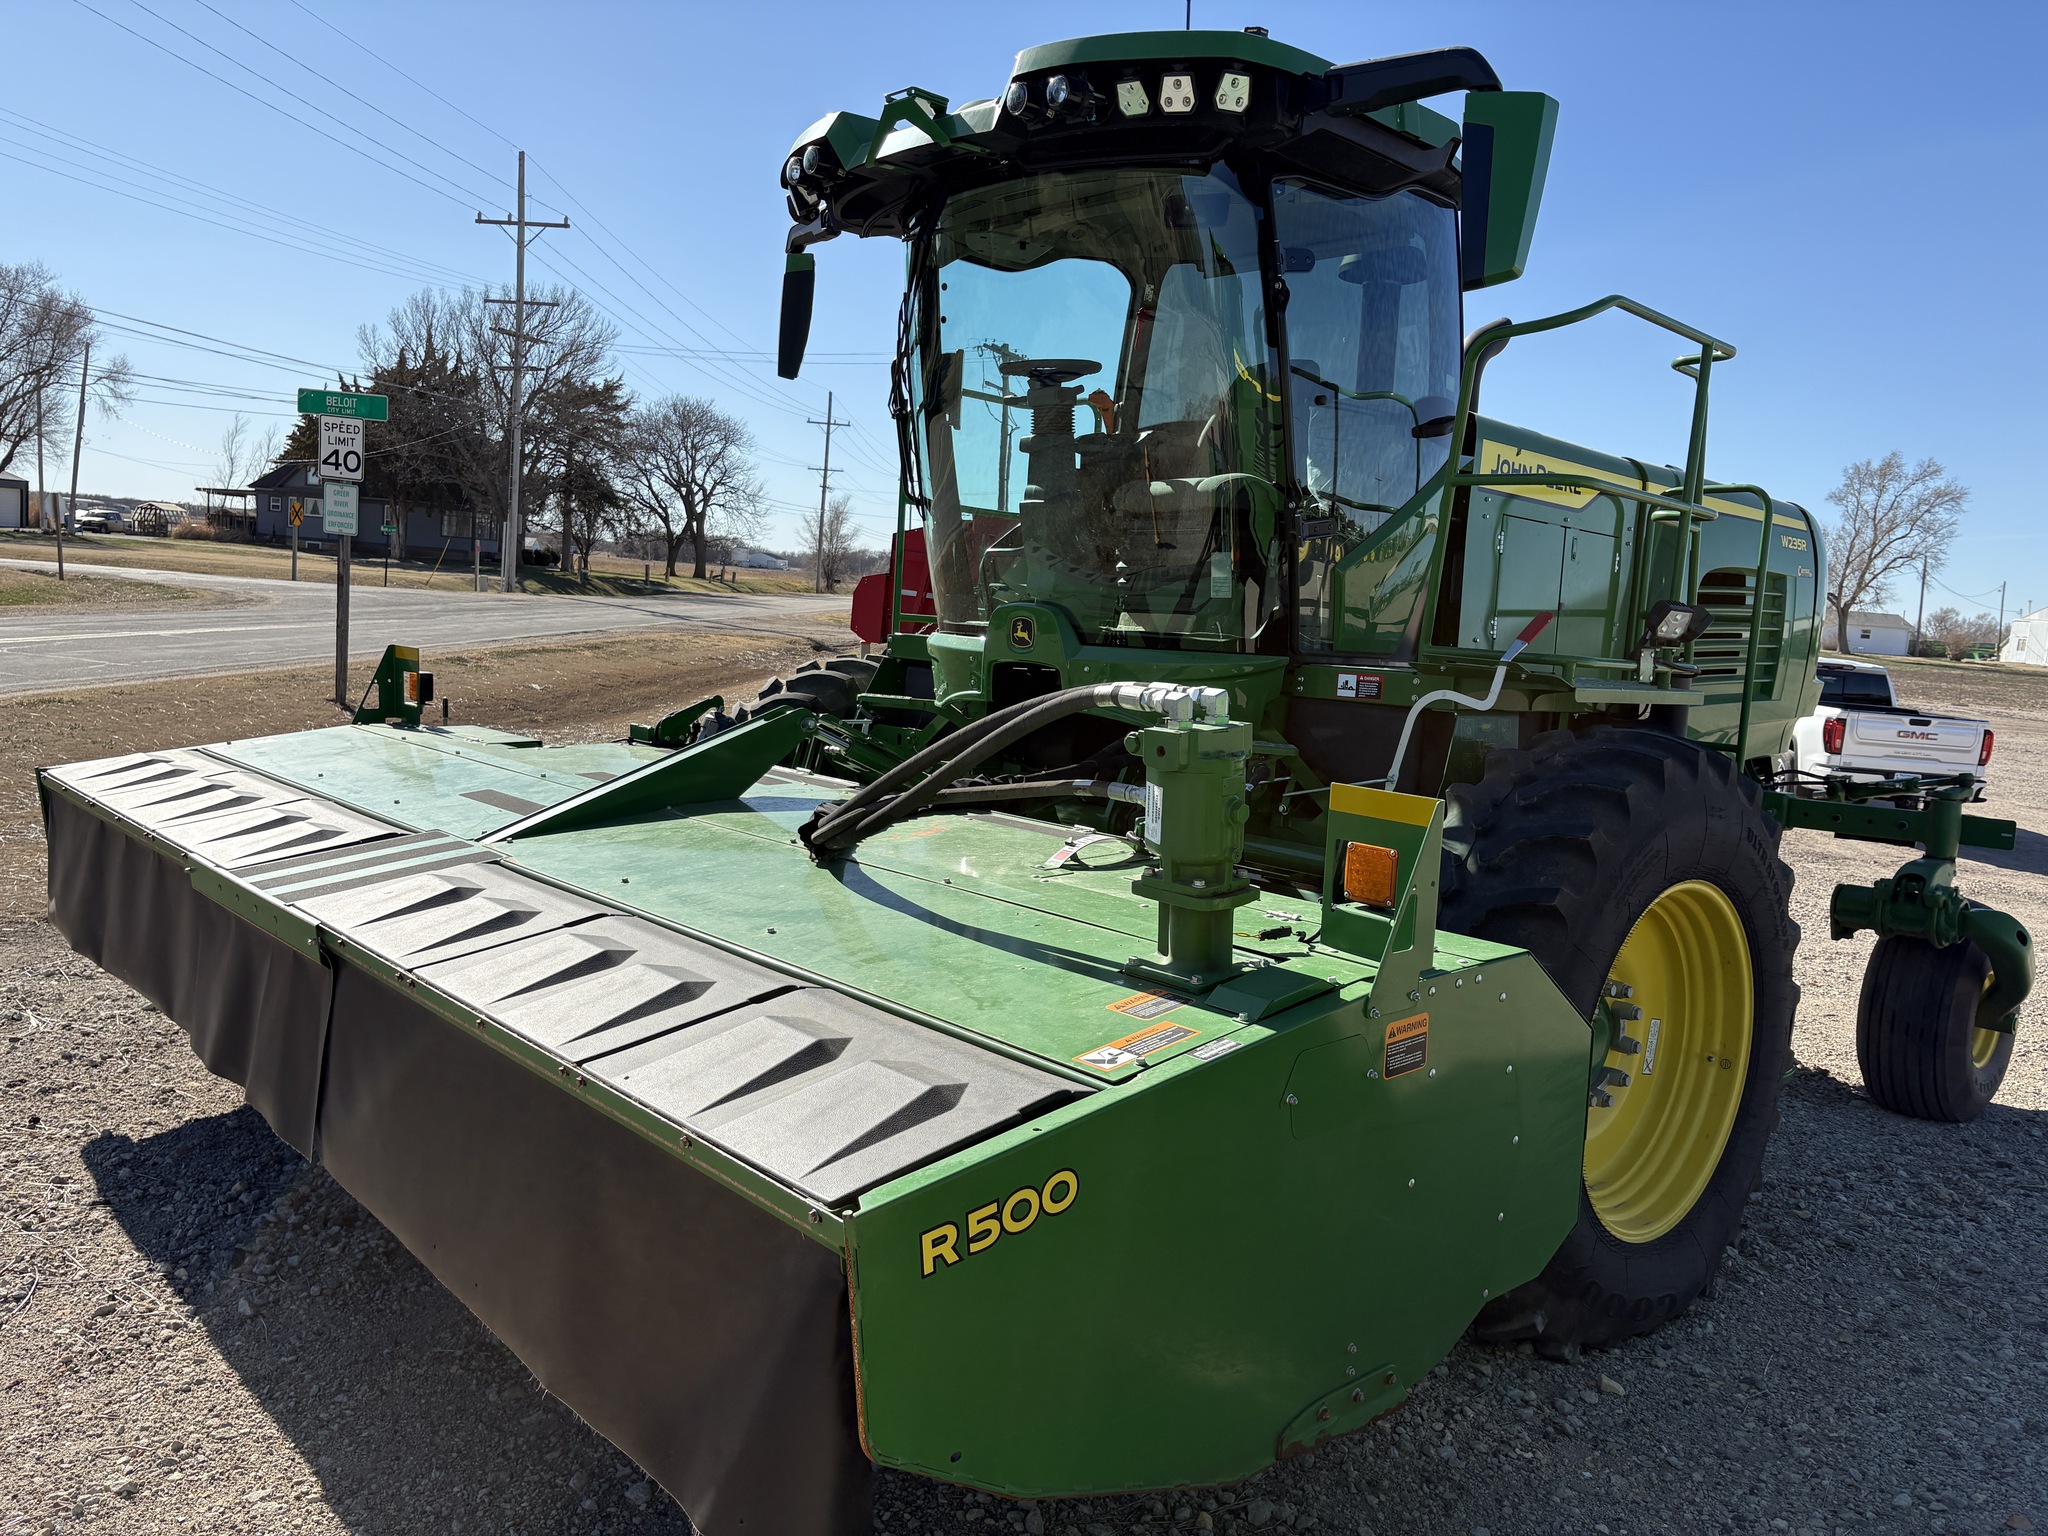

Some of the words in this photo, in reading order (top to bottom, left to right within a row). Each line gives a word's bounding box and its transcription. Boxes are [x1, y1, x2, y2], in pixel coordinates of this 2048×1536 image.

[326, 396, 358, 408] BELOIT
[323, 422, 361, 435] SPEED
[327, 435, 356, 447] LIMIT
[322, 449, 361, 473] 40
[1491, 454, 1532, 475] JOHN
[333, 489, 350, 498] GREEN
[333, 499, 349, 508] RIVER
[326, 510, 355, 519] ORDINANCE
[327, 521, 354, 530] ENFORCED
[1780, 535, 1807, 551] W235R
[1896, 730, 1939, 741] GMC
[1396, 1018, 1428, 1036] WARNING
